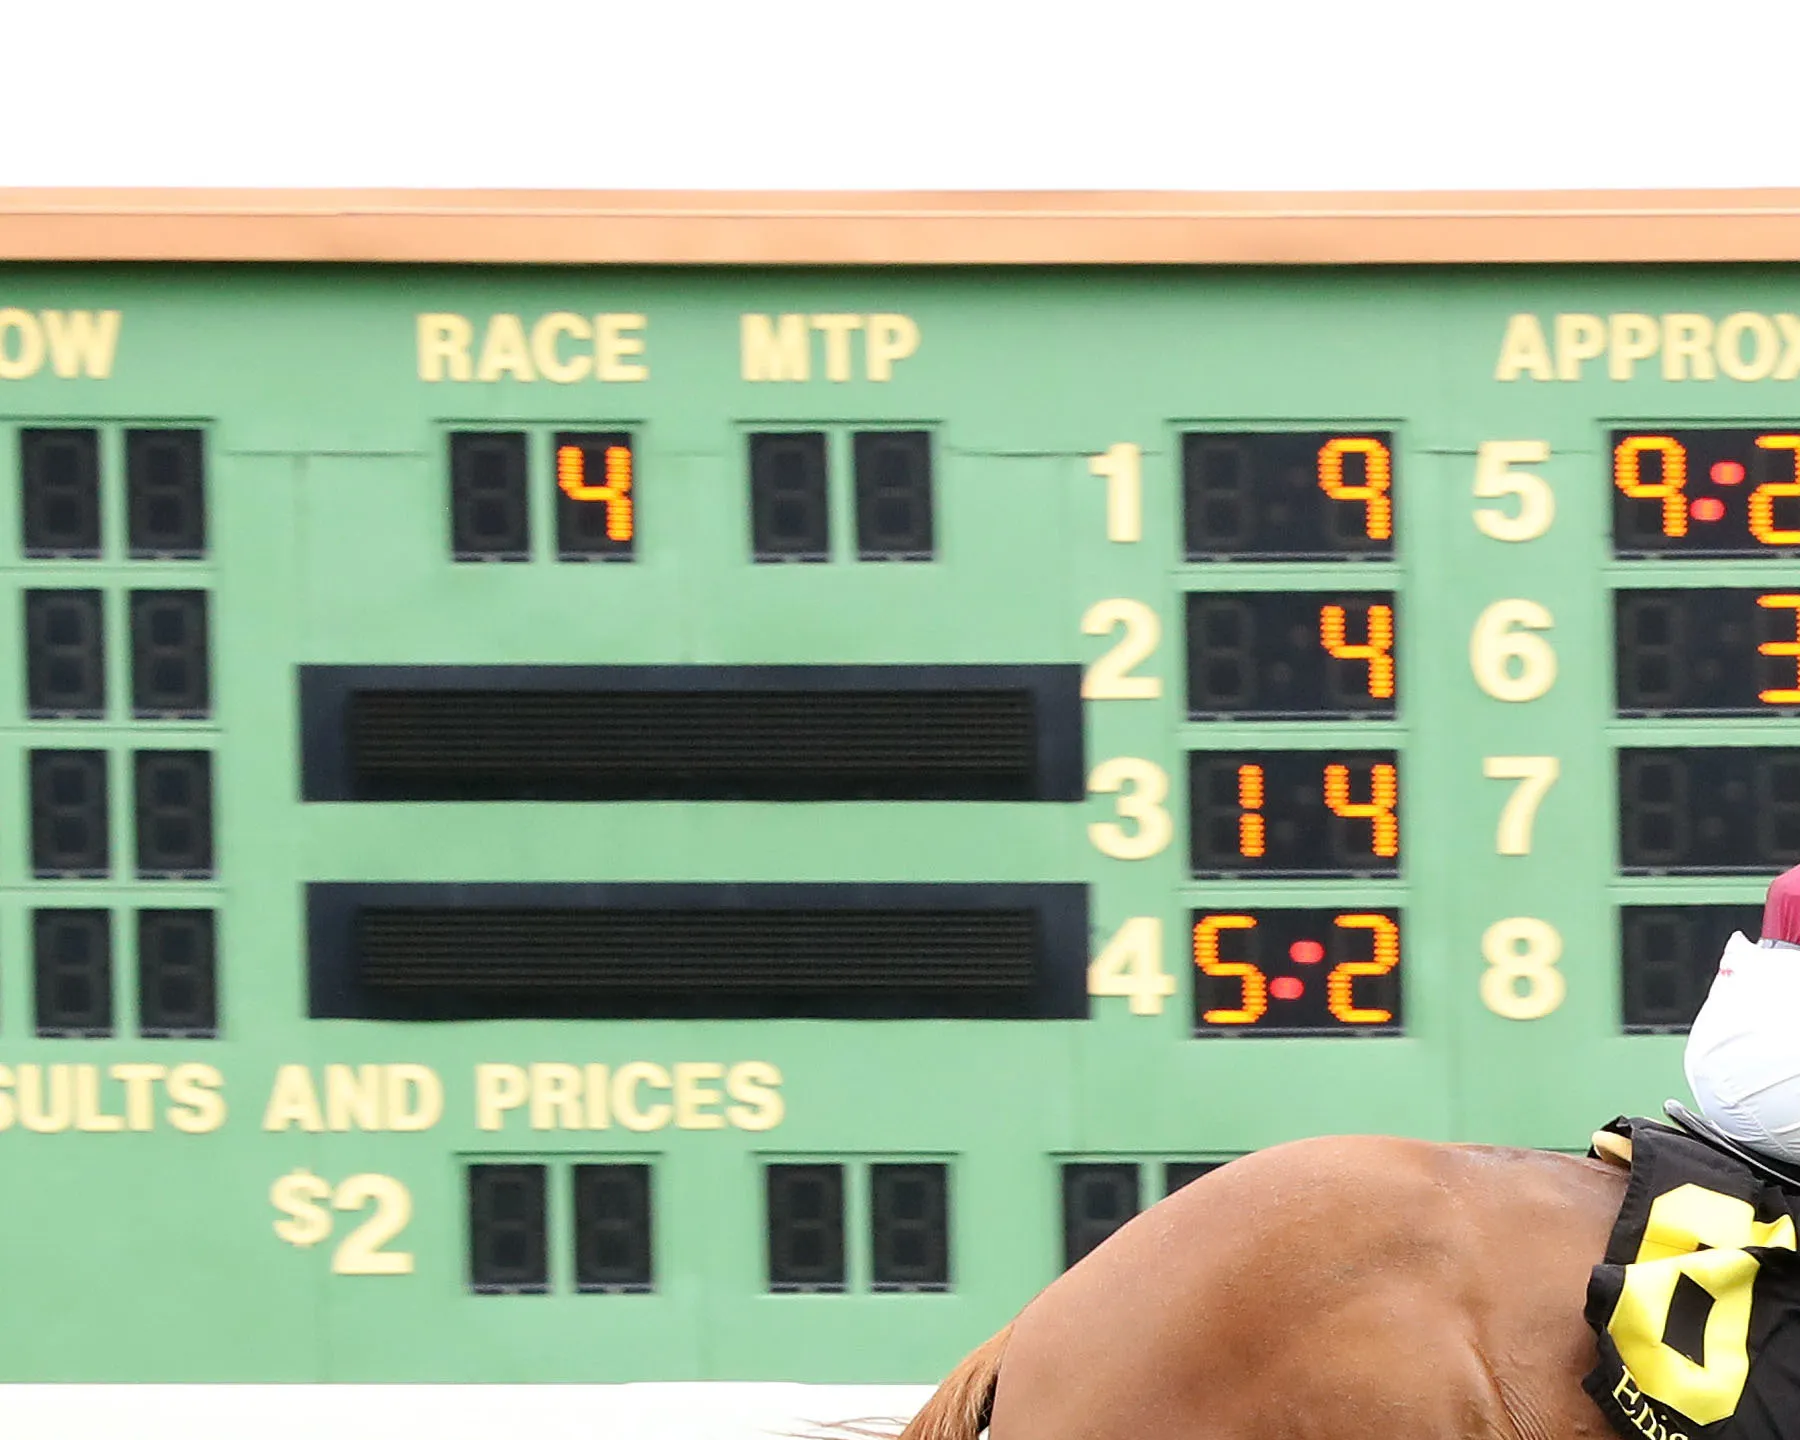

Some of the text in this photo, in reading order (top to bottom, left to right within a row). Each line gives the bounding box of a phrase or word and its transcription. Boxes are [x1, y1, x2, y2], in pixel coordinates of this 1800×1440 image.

[417, 311, 650, 384] RACE
[740, 311, 922, 383] MTP
[558, 445, 634, 542] 4
[1086, 441, 1143, 543] 1
[1317, 436, 1393, 541] 9
[1471, 438, 1557, 543] 5
[1079, 596, 1163, 701] 2
[1319, 604, 1395, 699] 4
[1468, 597, 1559, 703] 6
[1086, 755, 1174, 861] 3
[1482, 754, 1561, 856] 7
[1089, 915, 1177, 1016] 4
[1479, 915, 1567, 1021] 8
[262, 1062, 445, 1133] AND
[474, 1059, 786, 1133] PRICES
[269, 1167, 415, 1276] $2
